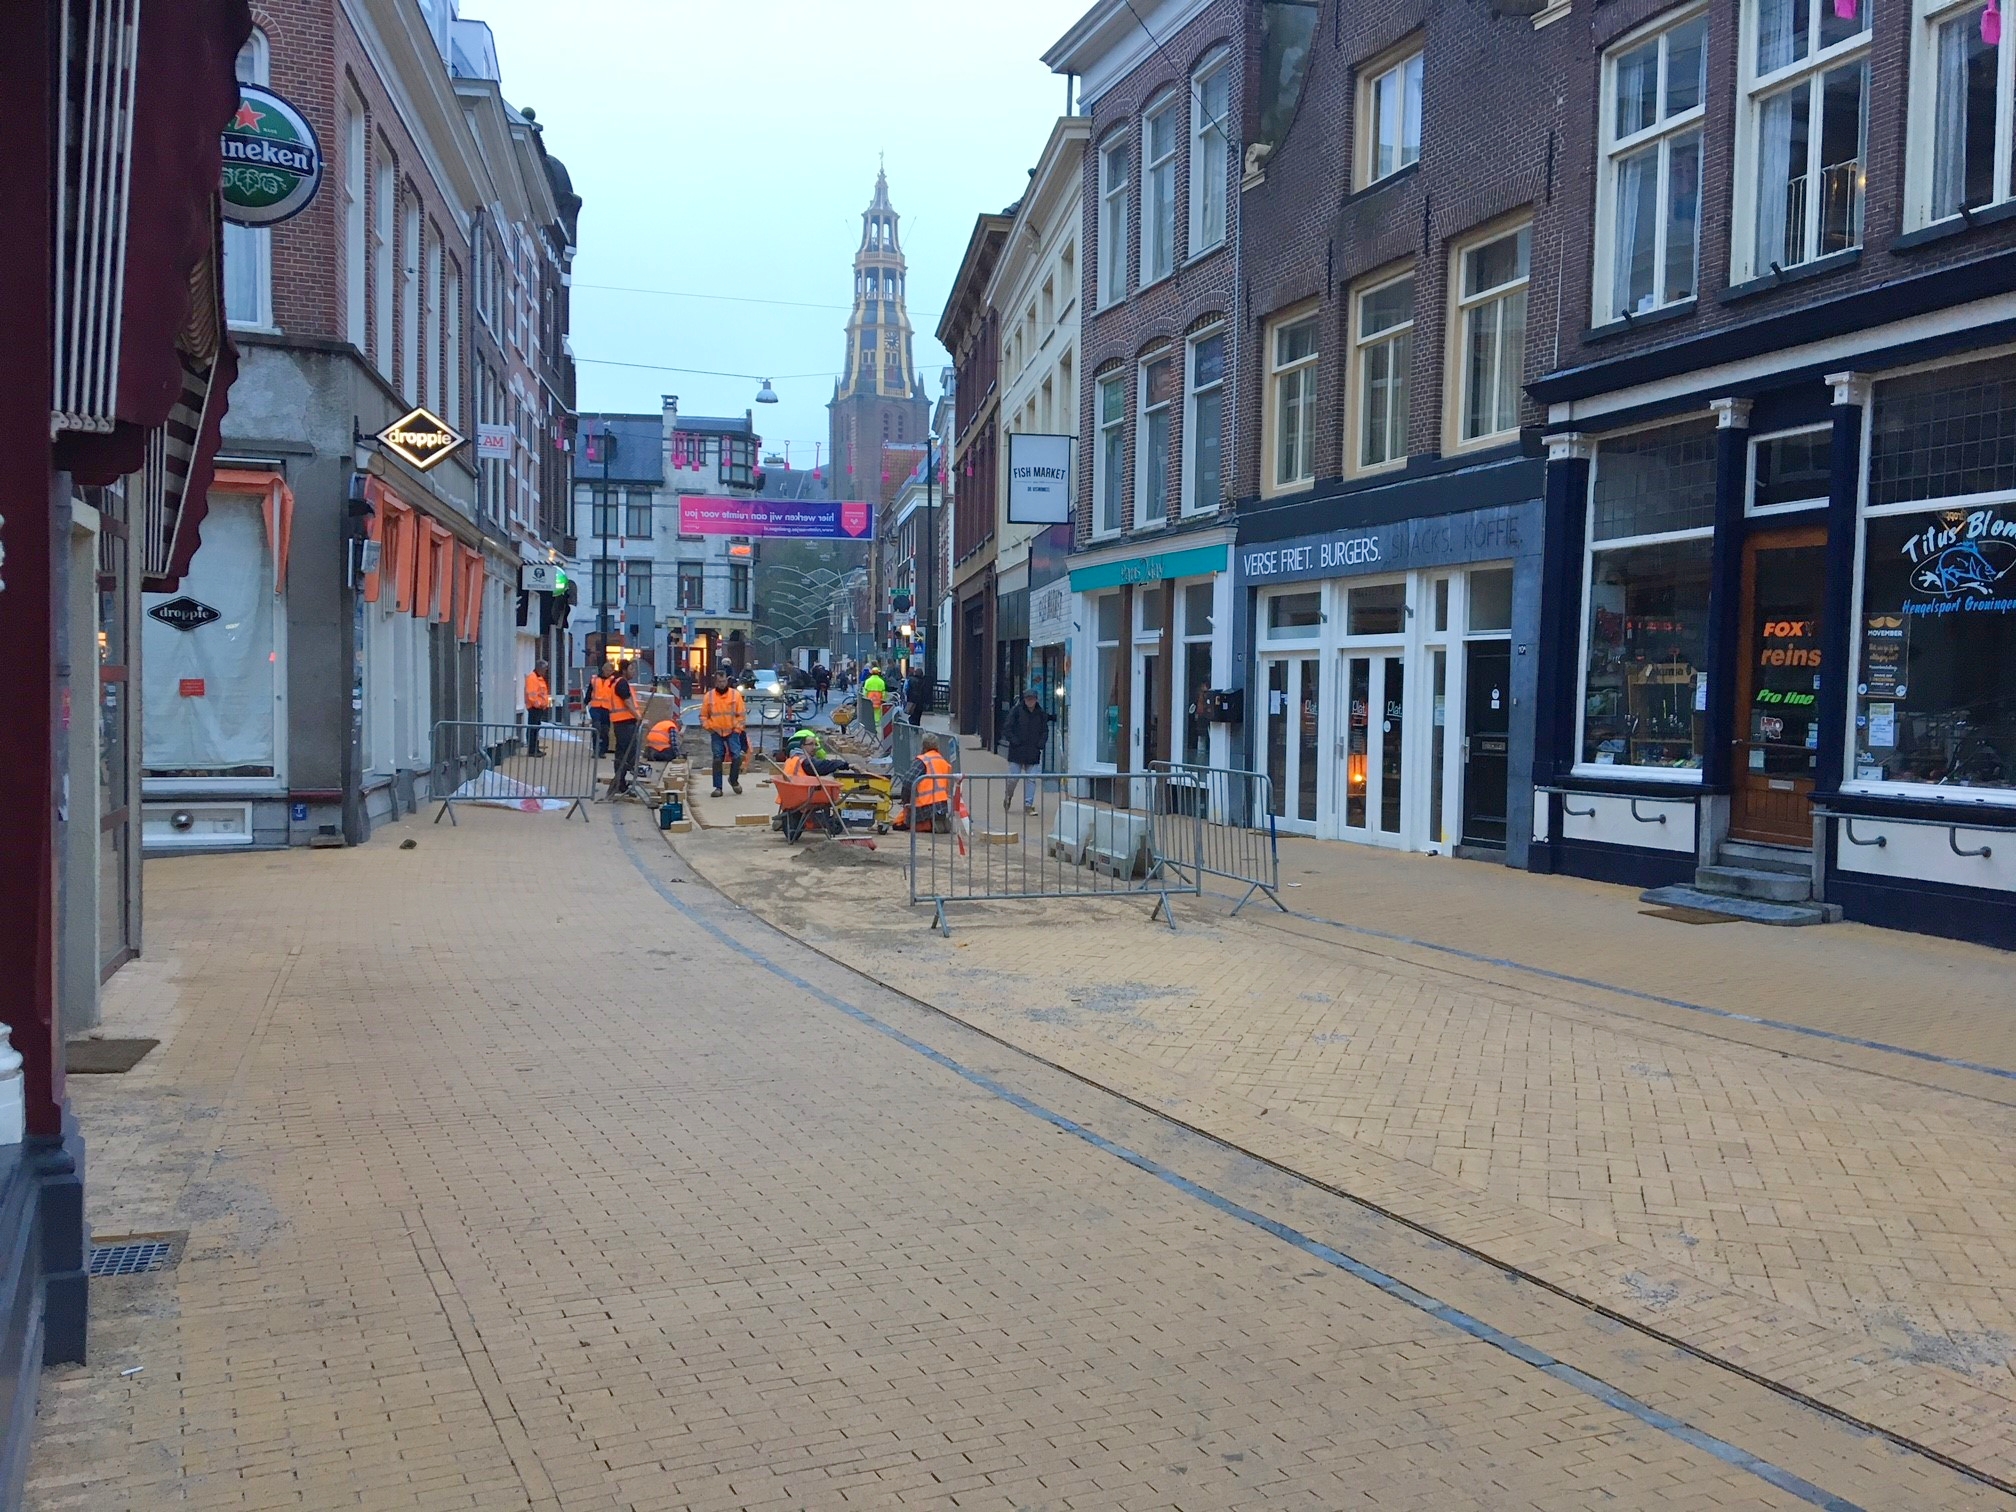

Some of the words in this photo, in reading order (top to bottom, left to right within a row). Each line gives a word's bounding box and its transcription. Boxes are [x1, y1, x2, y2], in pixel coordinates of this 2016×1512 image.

[221, 134, 309, 170] ineken
[388, 429, 452, 448] droppie
[482, 435, 504, 447] AM
[1013, 467, 1031, 479] FISH
[1033, 466, 1066, 480] MARKET
[1463, 516, 1523, 550] KOFFIE.
[1901, 526, 1957, 563] Titus
[1966, 510, 2016, 539] Blom
[1243, 550, 1278, 577] VERSE
[1280, 546, 1313, 573] FRIET.
[1320, 536, 1382, 568] BURGERS.
[160, 606, 209, 620] droppie
[1902, 597, 1962, 618] Hengelsport
[1763, 621, 1805, 637] FOX
[1760, 643, 1822, 667] reins
[1756, 688, 1782, 704] Pro
[1783, 691, 1815, 705] line
